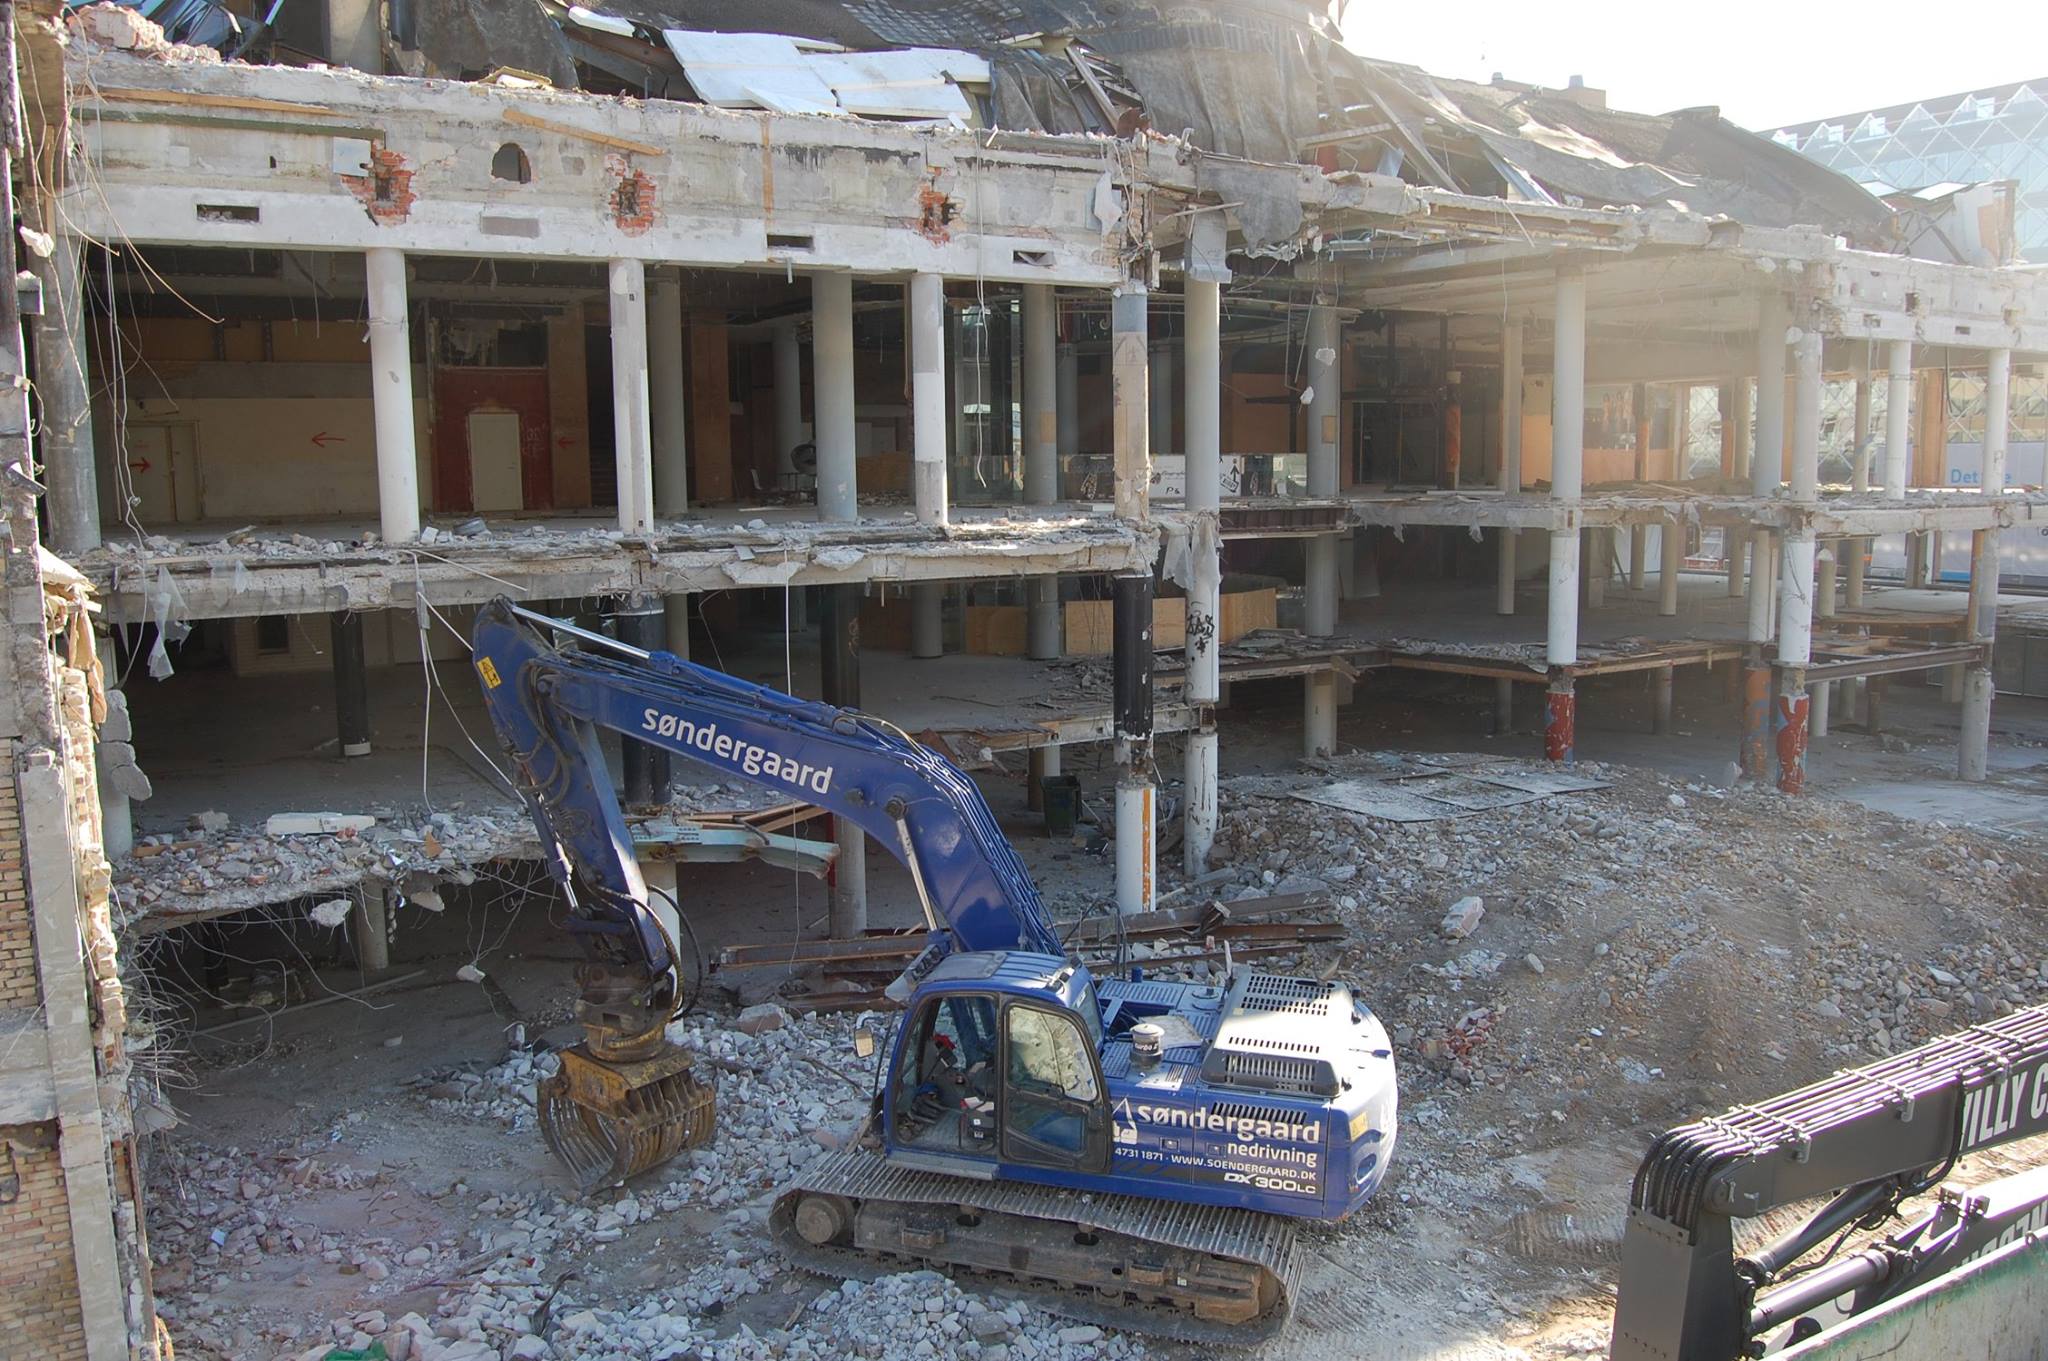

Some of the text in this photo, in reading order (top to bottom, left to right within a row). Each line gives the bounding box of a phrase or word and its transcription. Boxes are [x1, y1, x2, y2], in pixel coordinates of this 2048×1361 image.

[1951, 468, 1978, 484] Det
[642, 708, 833, 794] søndergaard
[1138, 1105, 1320, 1144] søndergaard
[1115, 1147, 1316, 1181] 4731 1871 WWW.SOENDERGAARD.DK
[1227, 1142, 1317, 1168] nedrivning
[1224, 1172, 1258, 1184] DX
